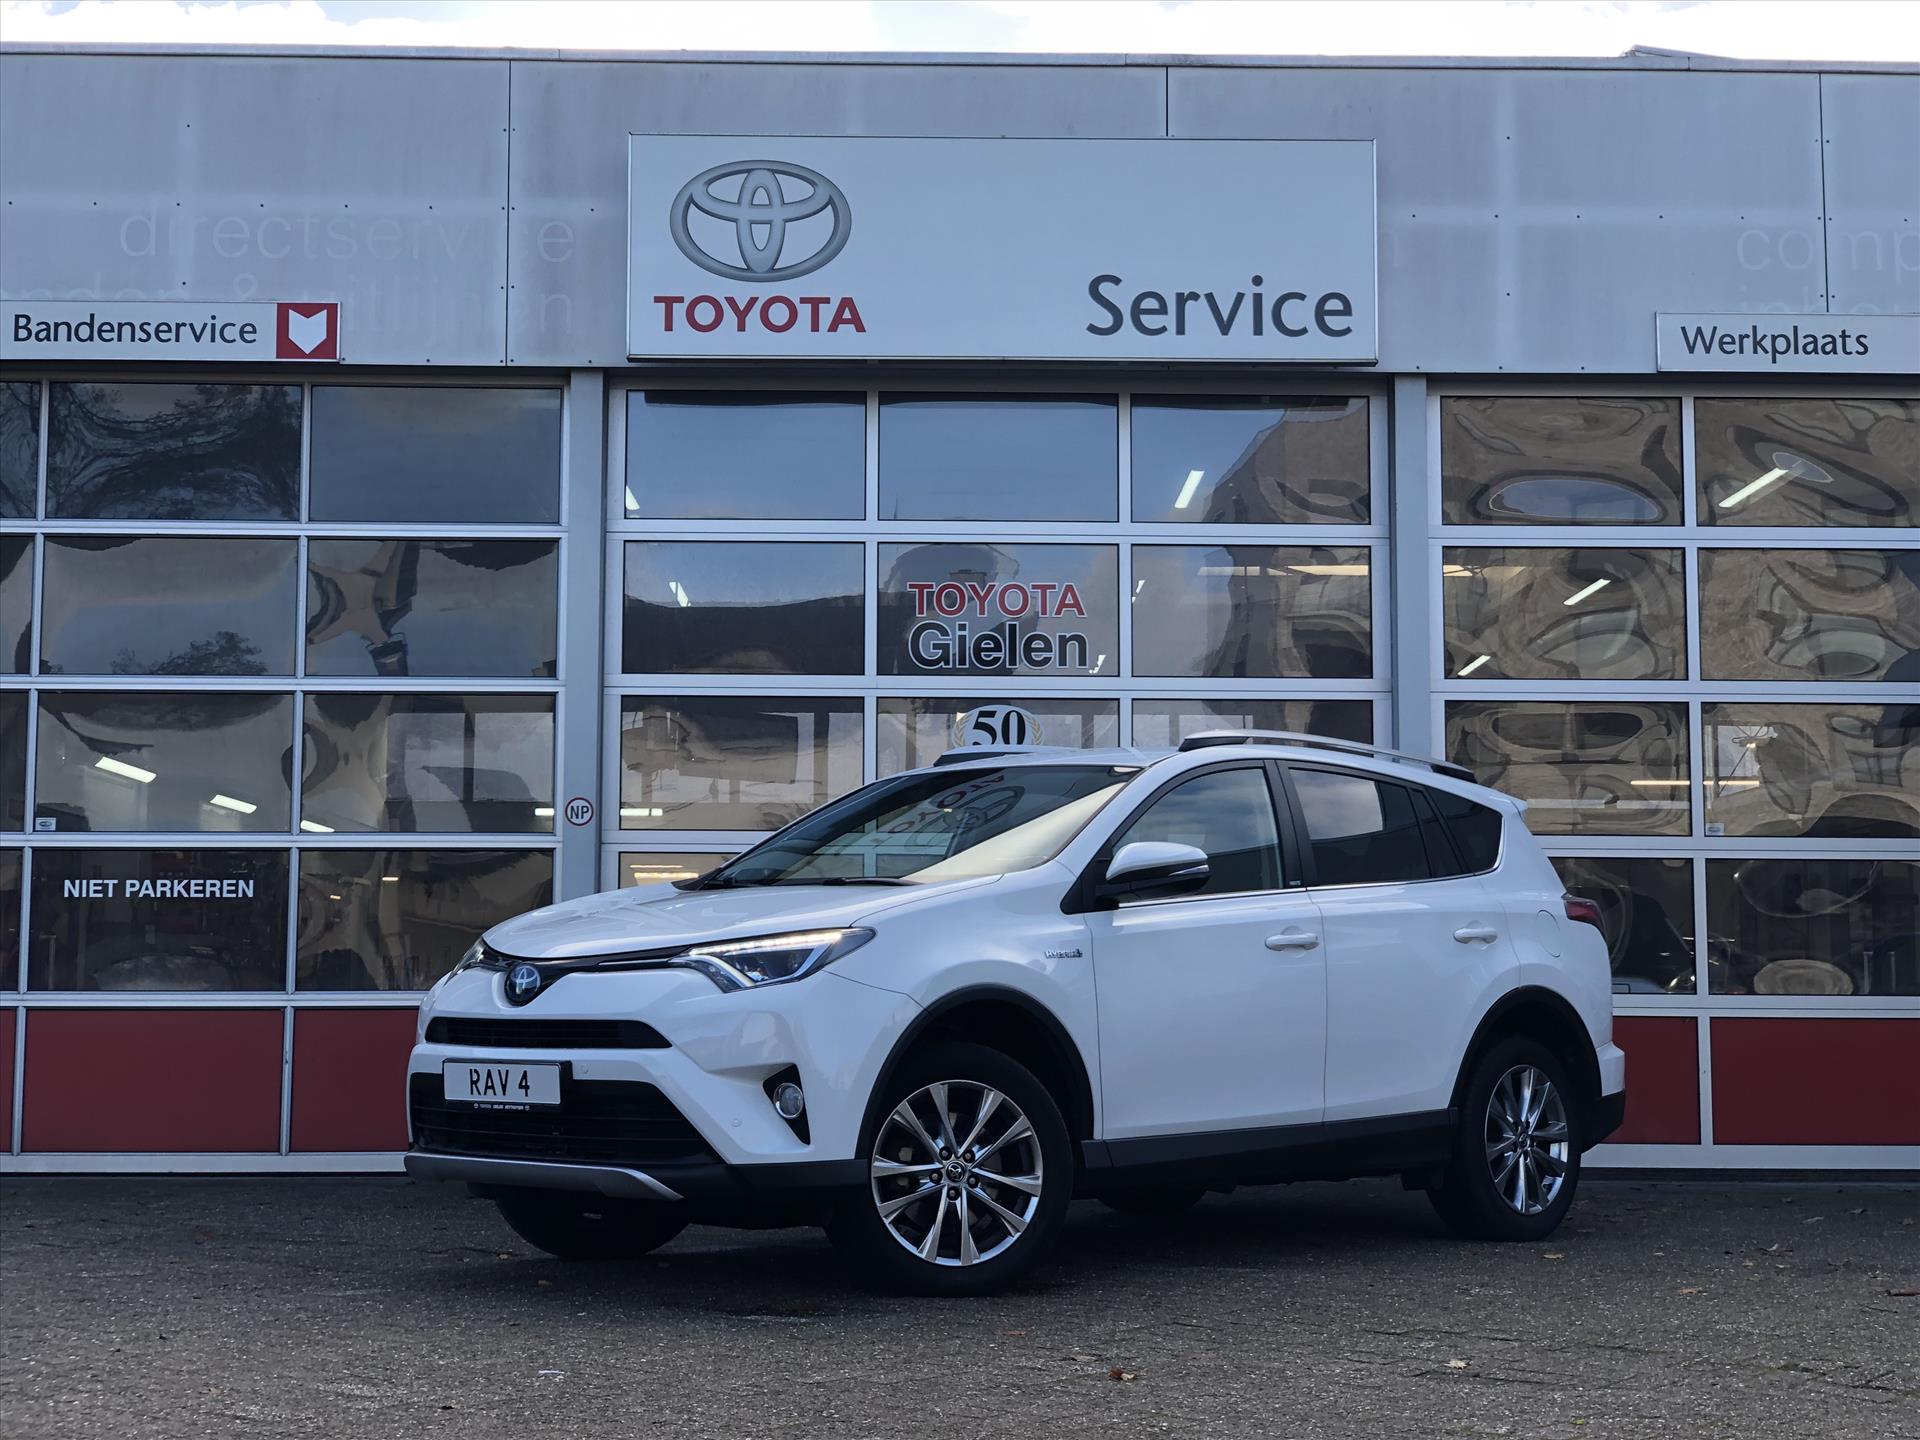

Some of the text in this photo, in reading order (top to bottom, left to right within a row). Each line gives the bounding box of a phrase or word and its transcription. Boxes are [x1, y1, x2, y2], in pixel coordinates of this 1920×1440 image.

[653, 294, 867, 333] TOYOTA
[1085, 274, 1353, 337] Service
[13, 313, 258, 344] Bandenservice
[1680, 325, 1869, 364] Werkplaats
[907, 581, 1088, 617] TOYOTA
[908, 620, 1089, 669] Gielen
[972, 710, 1027, 746] 50
[570, 805, 590, 820] NP
[63, 879, 255, 898] NIET PARKEREN
[469, 1068, 530, 1098] RAV 4
